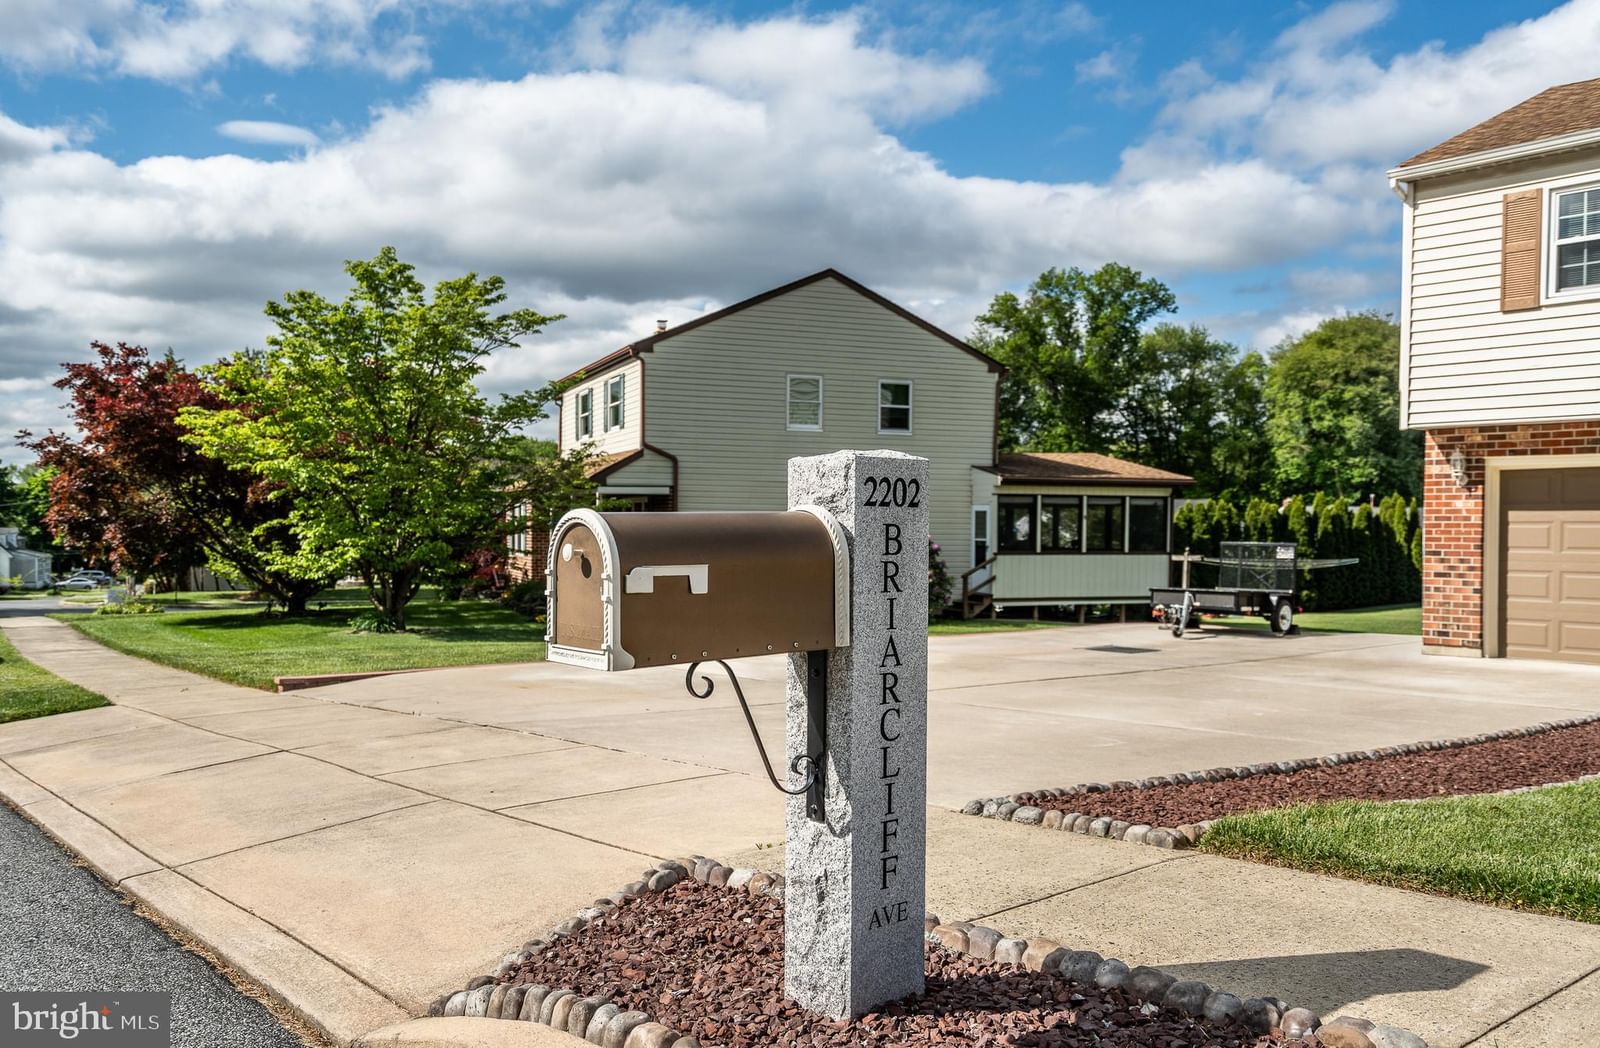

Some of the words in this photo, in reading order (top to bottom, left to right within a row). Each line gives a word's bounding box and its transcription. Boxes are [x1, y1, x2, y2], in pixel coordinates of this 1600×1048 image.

[863, 476, 921, 508] 2202
[879, 523, 903, 891] BRIARCLIFF
[868, 901, 909, 931] AVE
